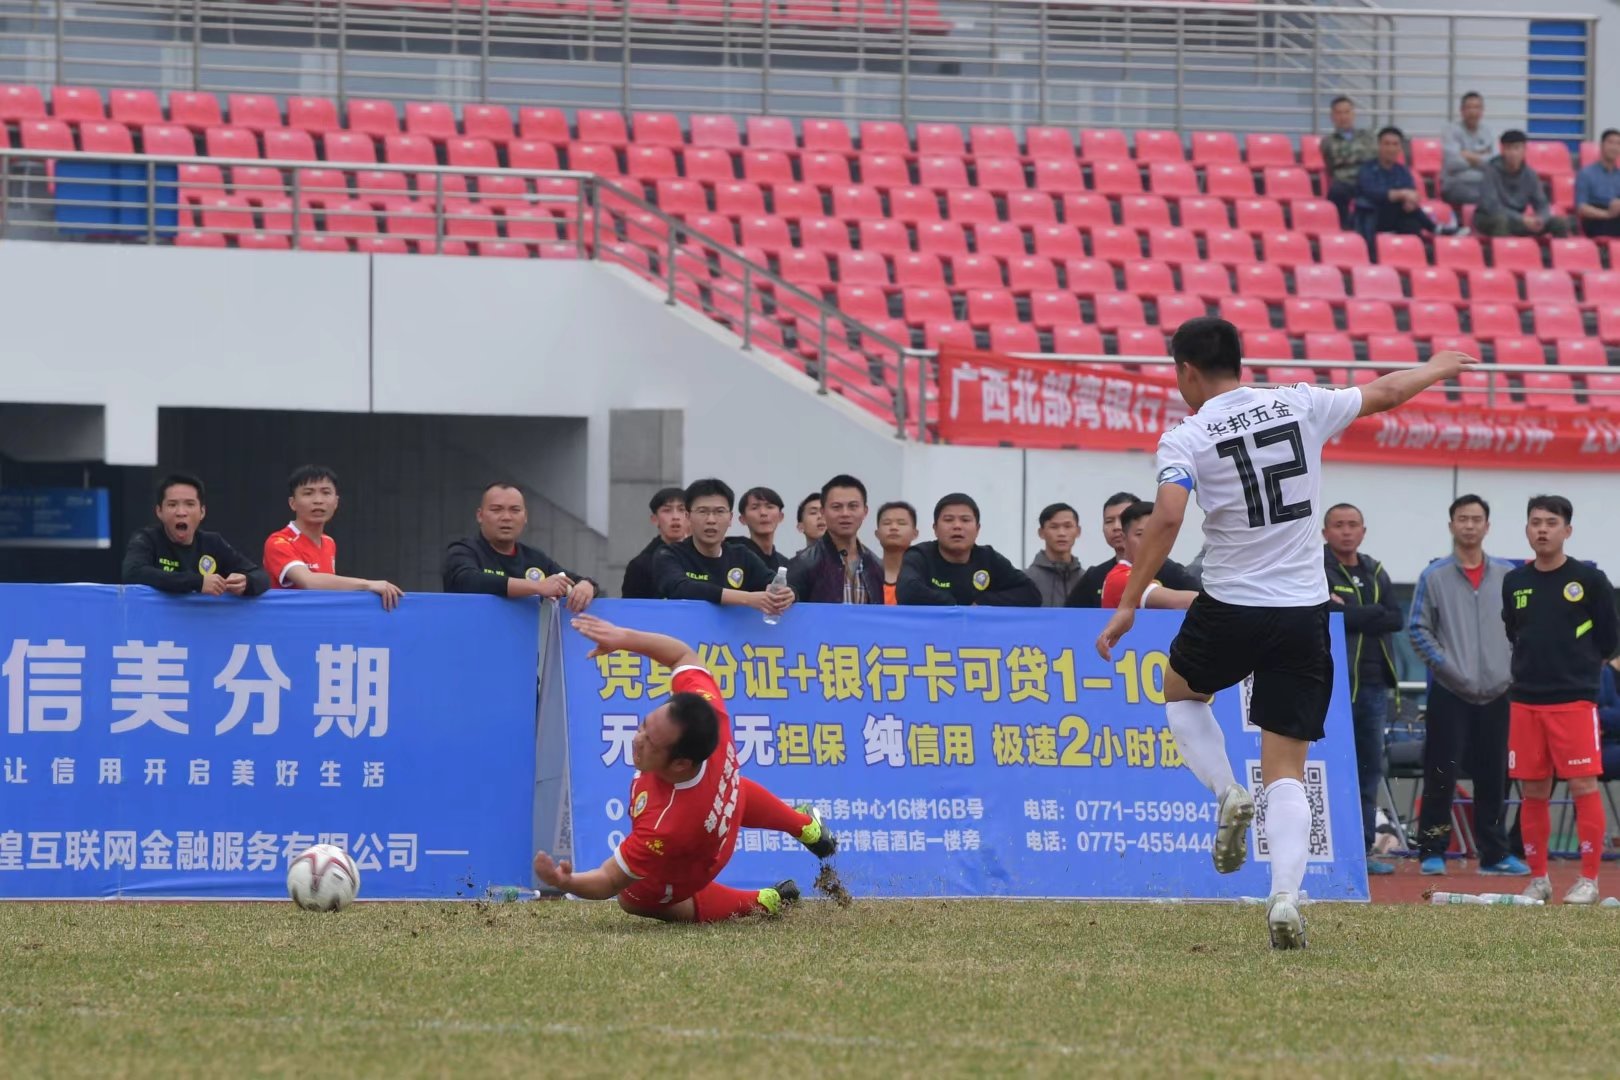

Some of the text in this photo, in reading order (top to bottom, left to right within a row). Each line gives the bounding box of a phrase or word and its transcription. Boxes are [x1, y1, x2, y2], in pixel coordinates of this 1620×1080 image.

[1206, 400, 1293, 437] 华邦五金
[1216, 421, 1312, 528] 12
[2, 638, 390, 739] 信美分期
[596, 642, 1216, 705] 凭份证+银行卡可贷1-10
[734, 713, 847, 767] 无担保
[863, 714, 975, 767] 纯信用
[4, 757, 385, 788] 让信用开启美好生活
[774, 797, 984, 820] 商务中心16楼16B号
[1026, 829, 1217, 854] 电话：0775-455444
